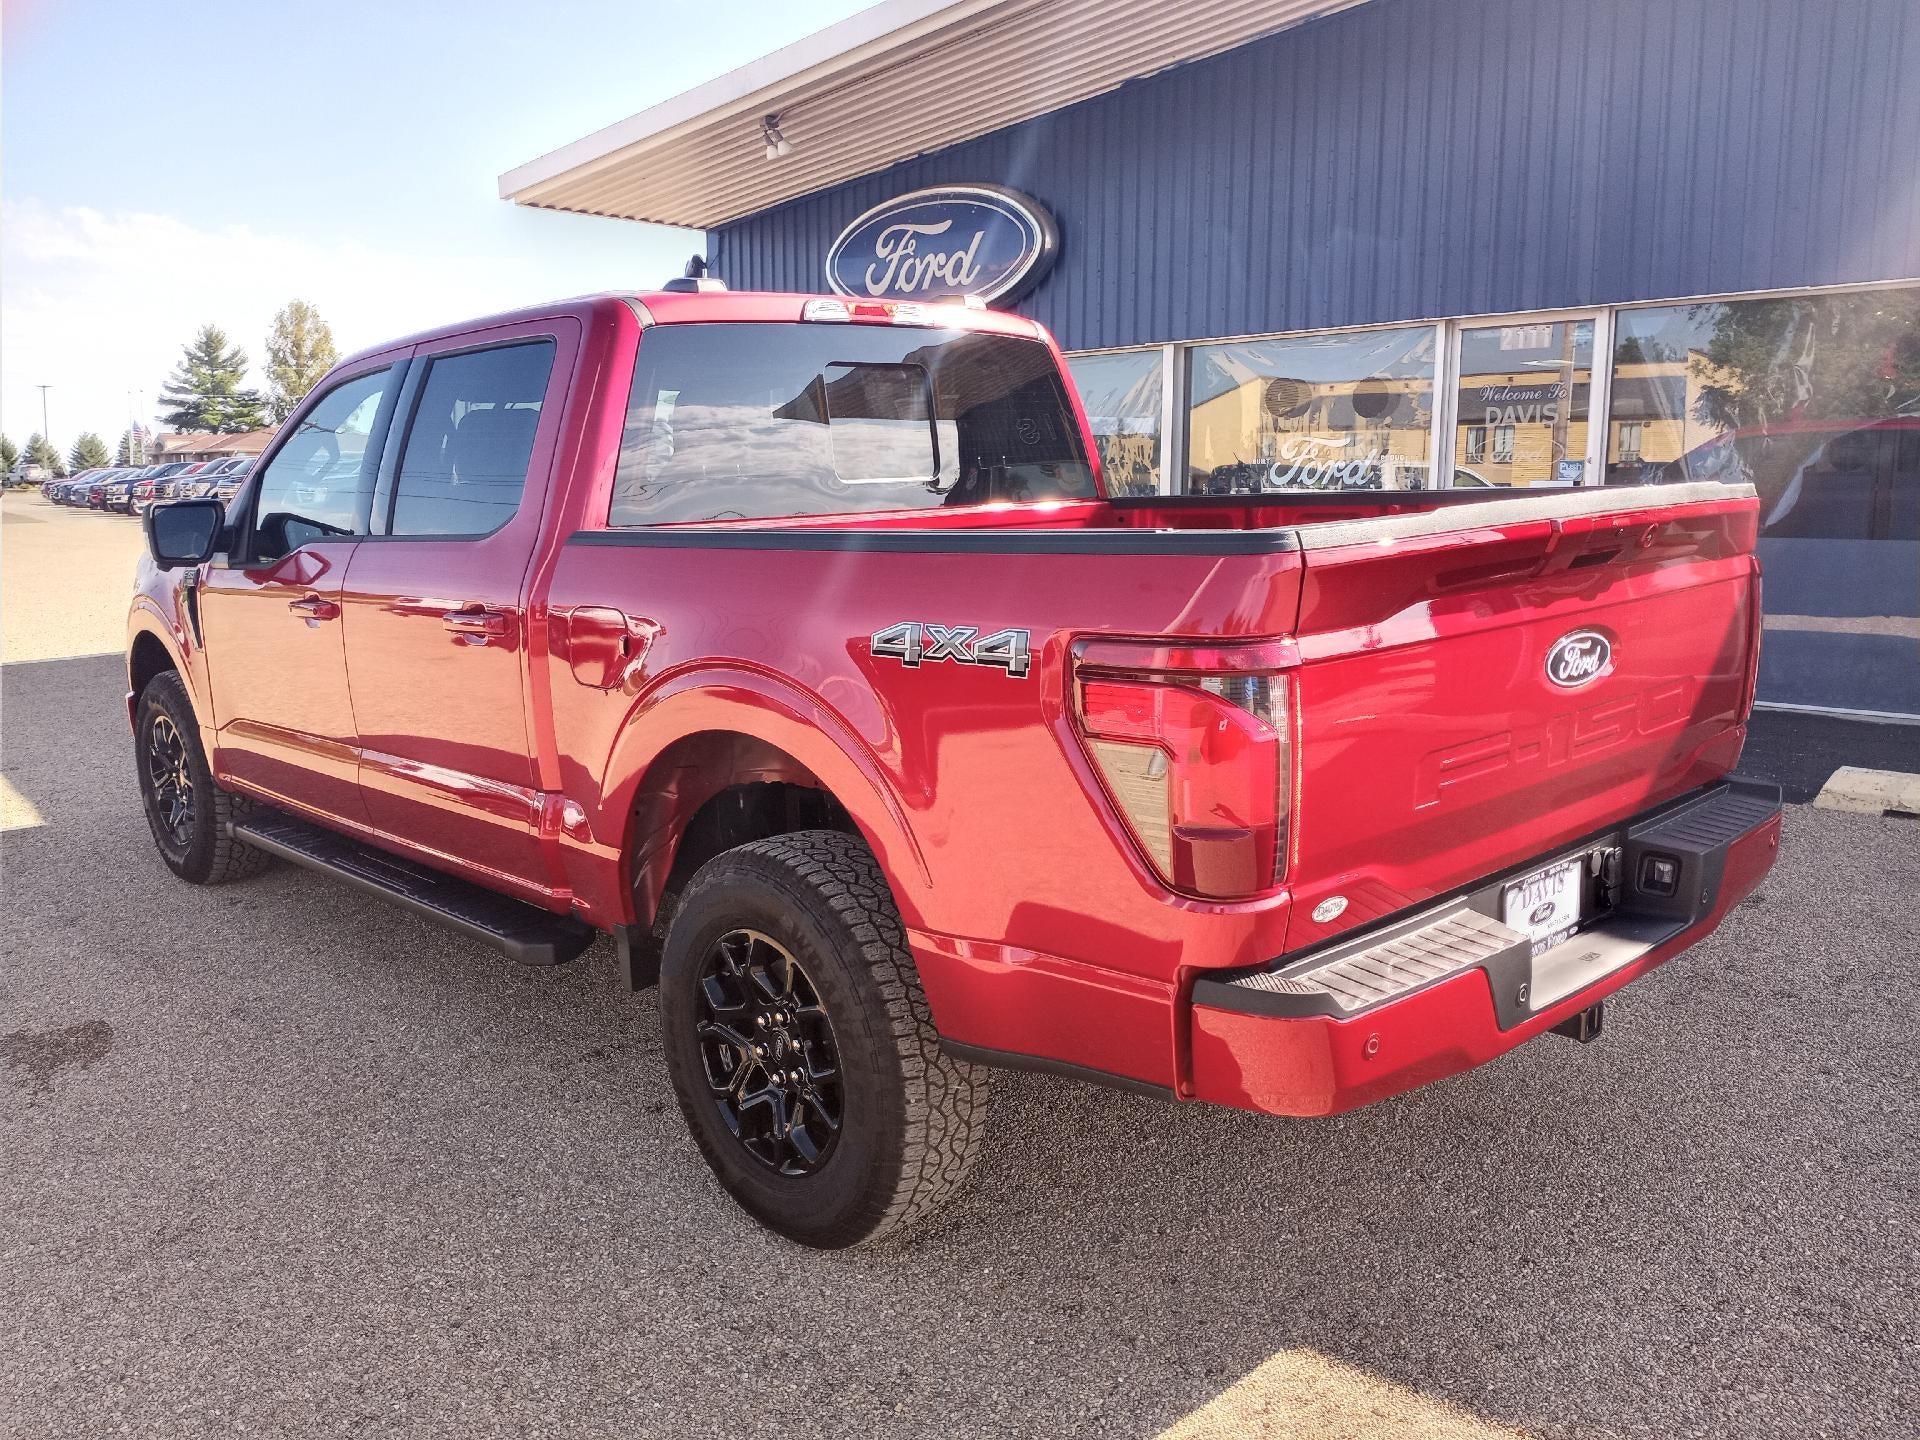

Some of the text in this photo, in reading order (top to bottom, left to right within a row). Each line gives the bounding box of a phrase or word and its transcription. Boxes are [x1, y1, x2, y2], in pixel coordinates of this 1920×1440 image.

[865, 219, 985, 297] Ford
[1480, 381, 1568, 402] Welcome To
[1485, 403, 1560, 427] DAVIS
[1270, 436, 1378, 486] Ford
[1561, 462, 1582, 471] Push
[1559, 639, 1601, 680] Ford
[1414, 676, 1696, 810] F-150
[1520, 871, 1565, 911] DAVIS
